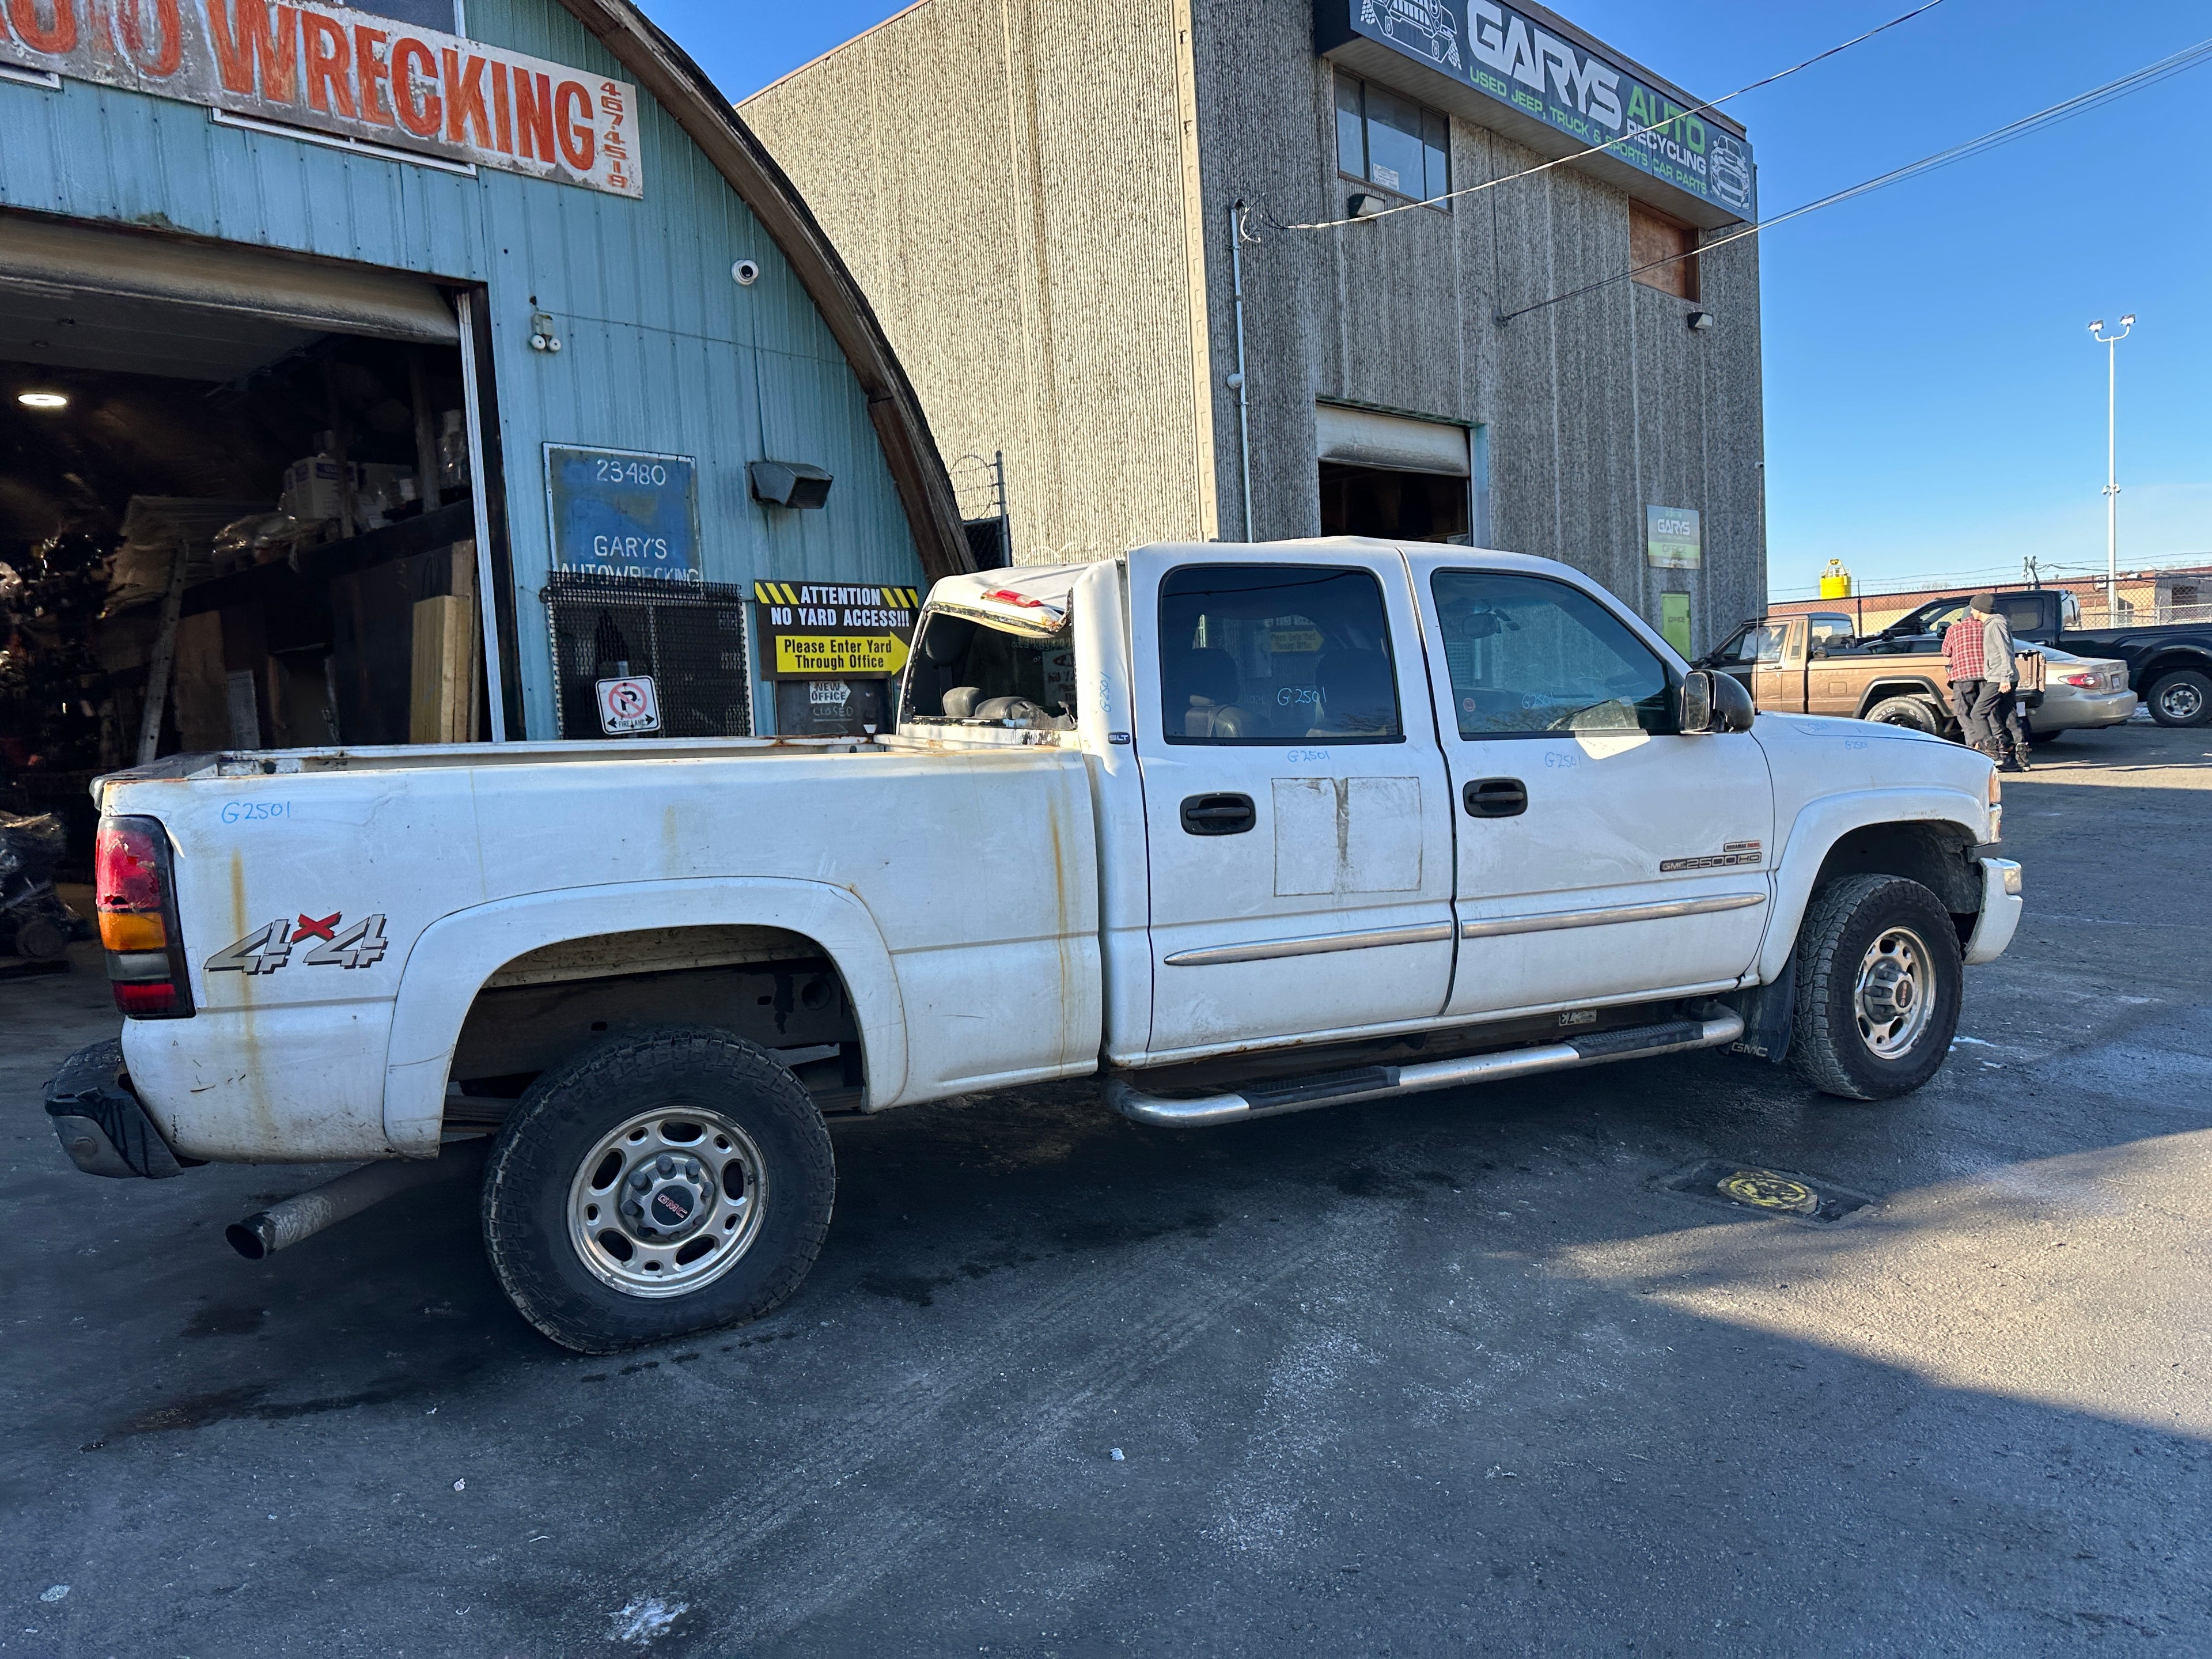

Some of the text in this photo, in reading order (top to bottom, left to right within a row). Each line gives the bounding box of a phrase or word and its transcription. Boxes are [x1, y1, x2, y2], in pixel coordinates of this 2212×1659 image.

[1467, 0, 1622, 130] GARYS
[207, 0, 595, 171] WRECKING
[1627, 85, 1705, 155] AUTO
[1469, 66, 1707, 195] USED JEEP, TRUCK & SPORTS CAR PARTS
[1627, 118, 1706, 175] RECYCLING
[597, 459, 666, 486] 23480
[1658, 518, 1690, 536] GARYS
[594, 535, 667, 559] GARY'S
[801, 586, 881, 605] ATTENTION
[771, 607, 910, 627] NO YARD ACCESS!!!
[785, 639, 892, 653] Please Enter Yard
[795, 654, 884, 671] Through Office
[815, 681, 841, 691] NEW
[811, 691, 847, 702] OFFICE
[1277, 687, 1327, 706] G2501
[813, 706, 854, 717] CLOSED
[618, 720, 630, 728] FIRE
[1287, 750, 1331, 763] G2501
[1544, 751, 1581, 768] G2501
[221, 801, 290, 824] G2501
[1732, 1041, 1768, 1057] GMC
[657, 1193, 688, 1219] GMC
